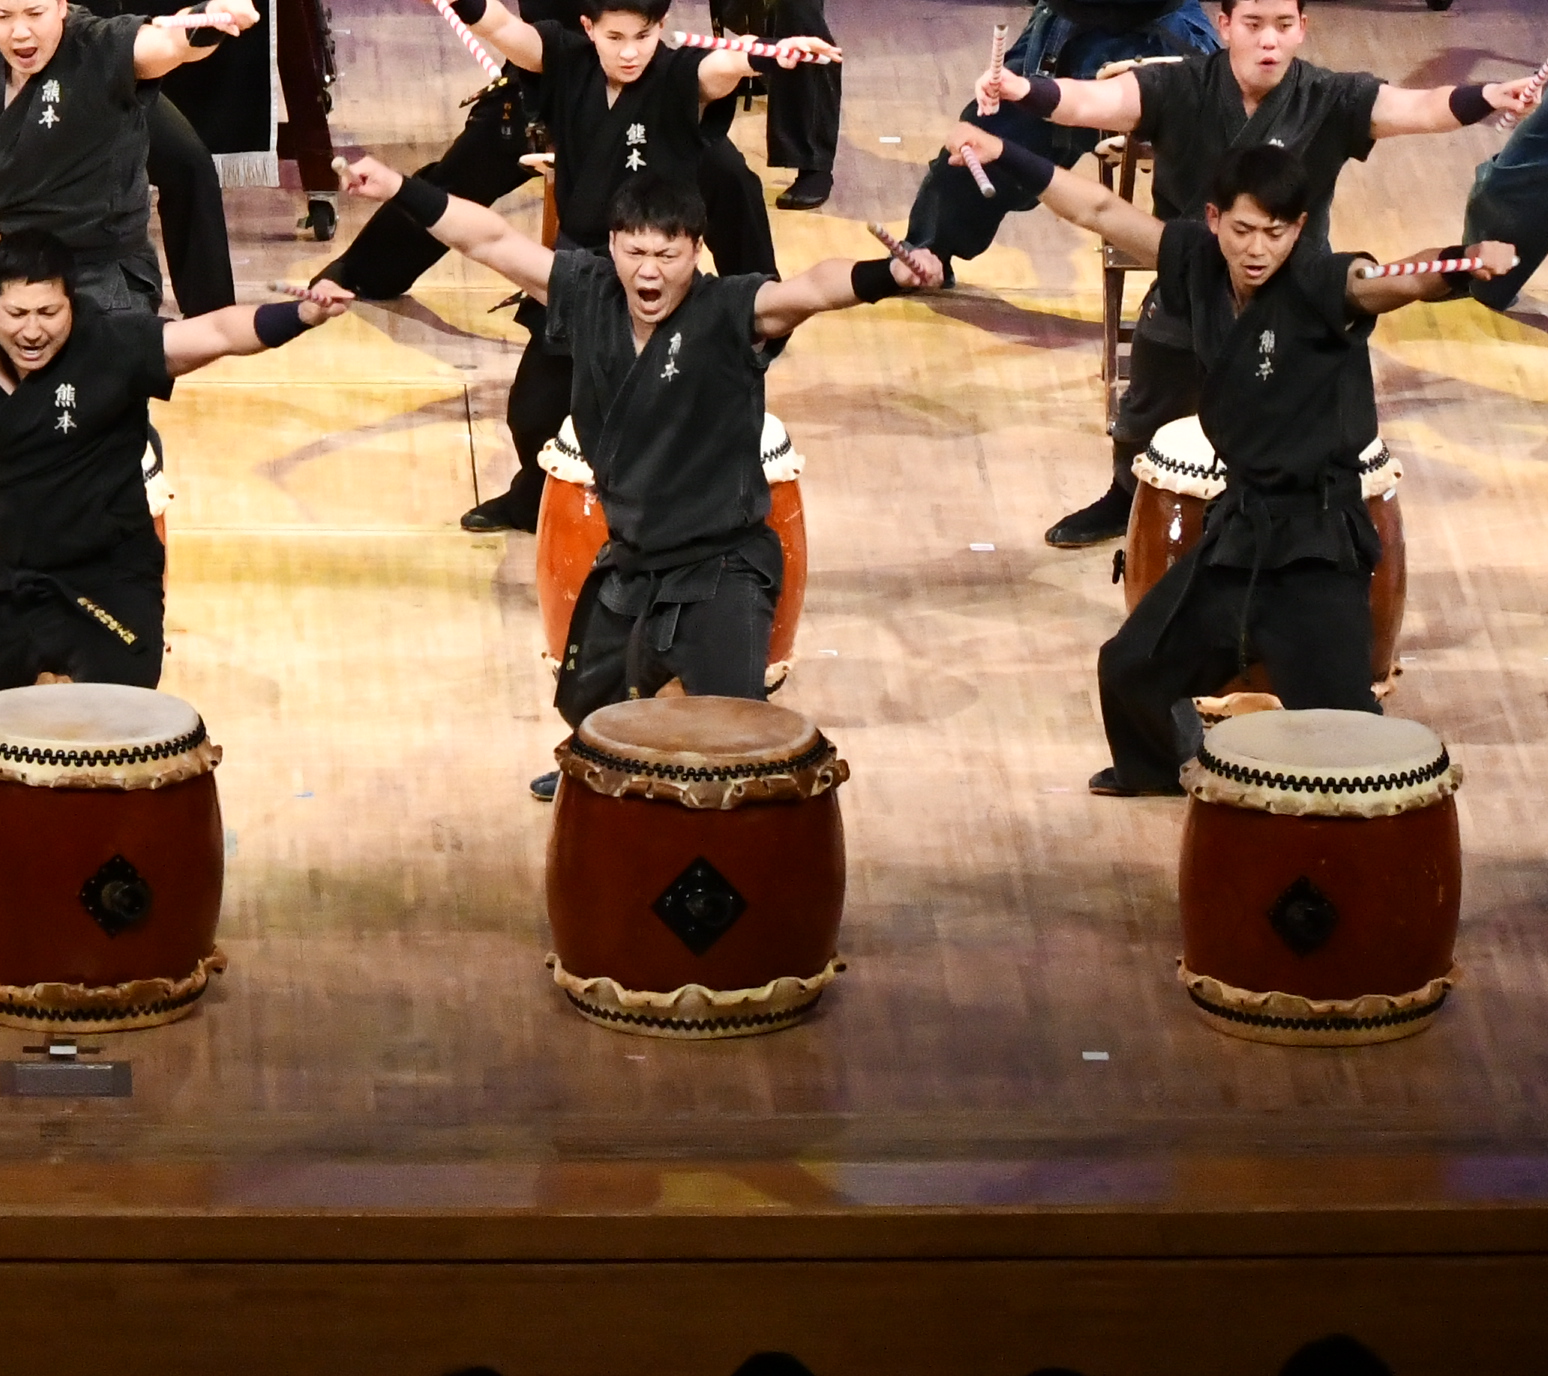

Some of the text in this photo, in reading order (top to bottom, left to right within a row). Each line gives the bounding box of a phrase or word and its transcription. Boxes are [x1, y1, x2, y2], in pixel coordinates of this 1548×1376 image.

[38, 79, 60, 129] 熊本
[625, 122, 647, 172] 熊本
[54, 382, 78, 435] 熊本
